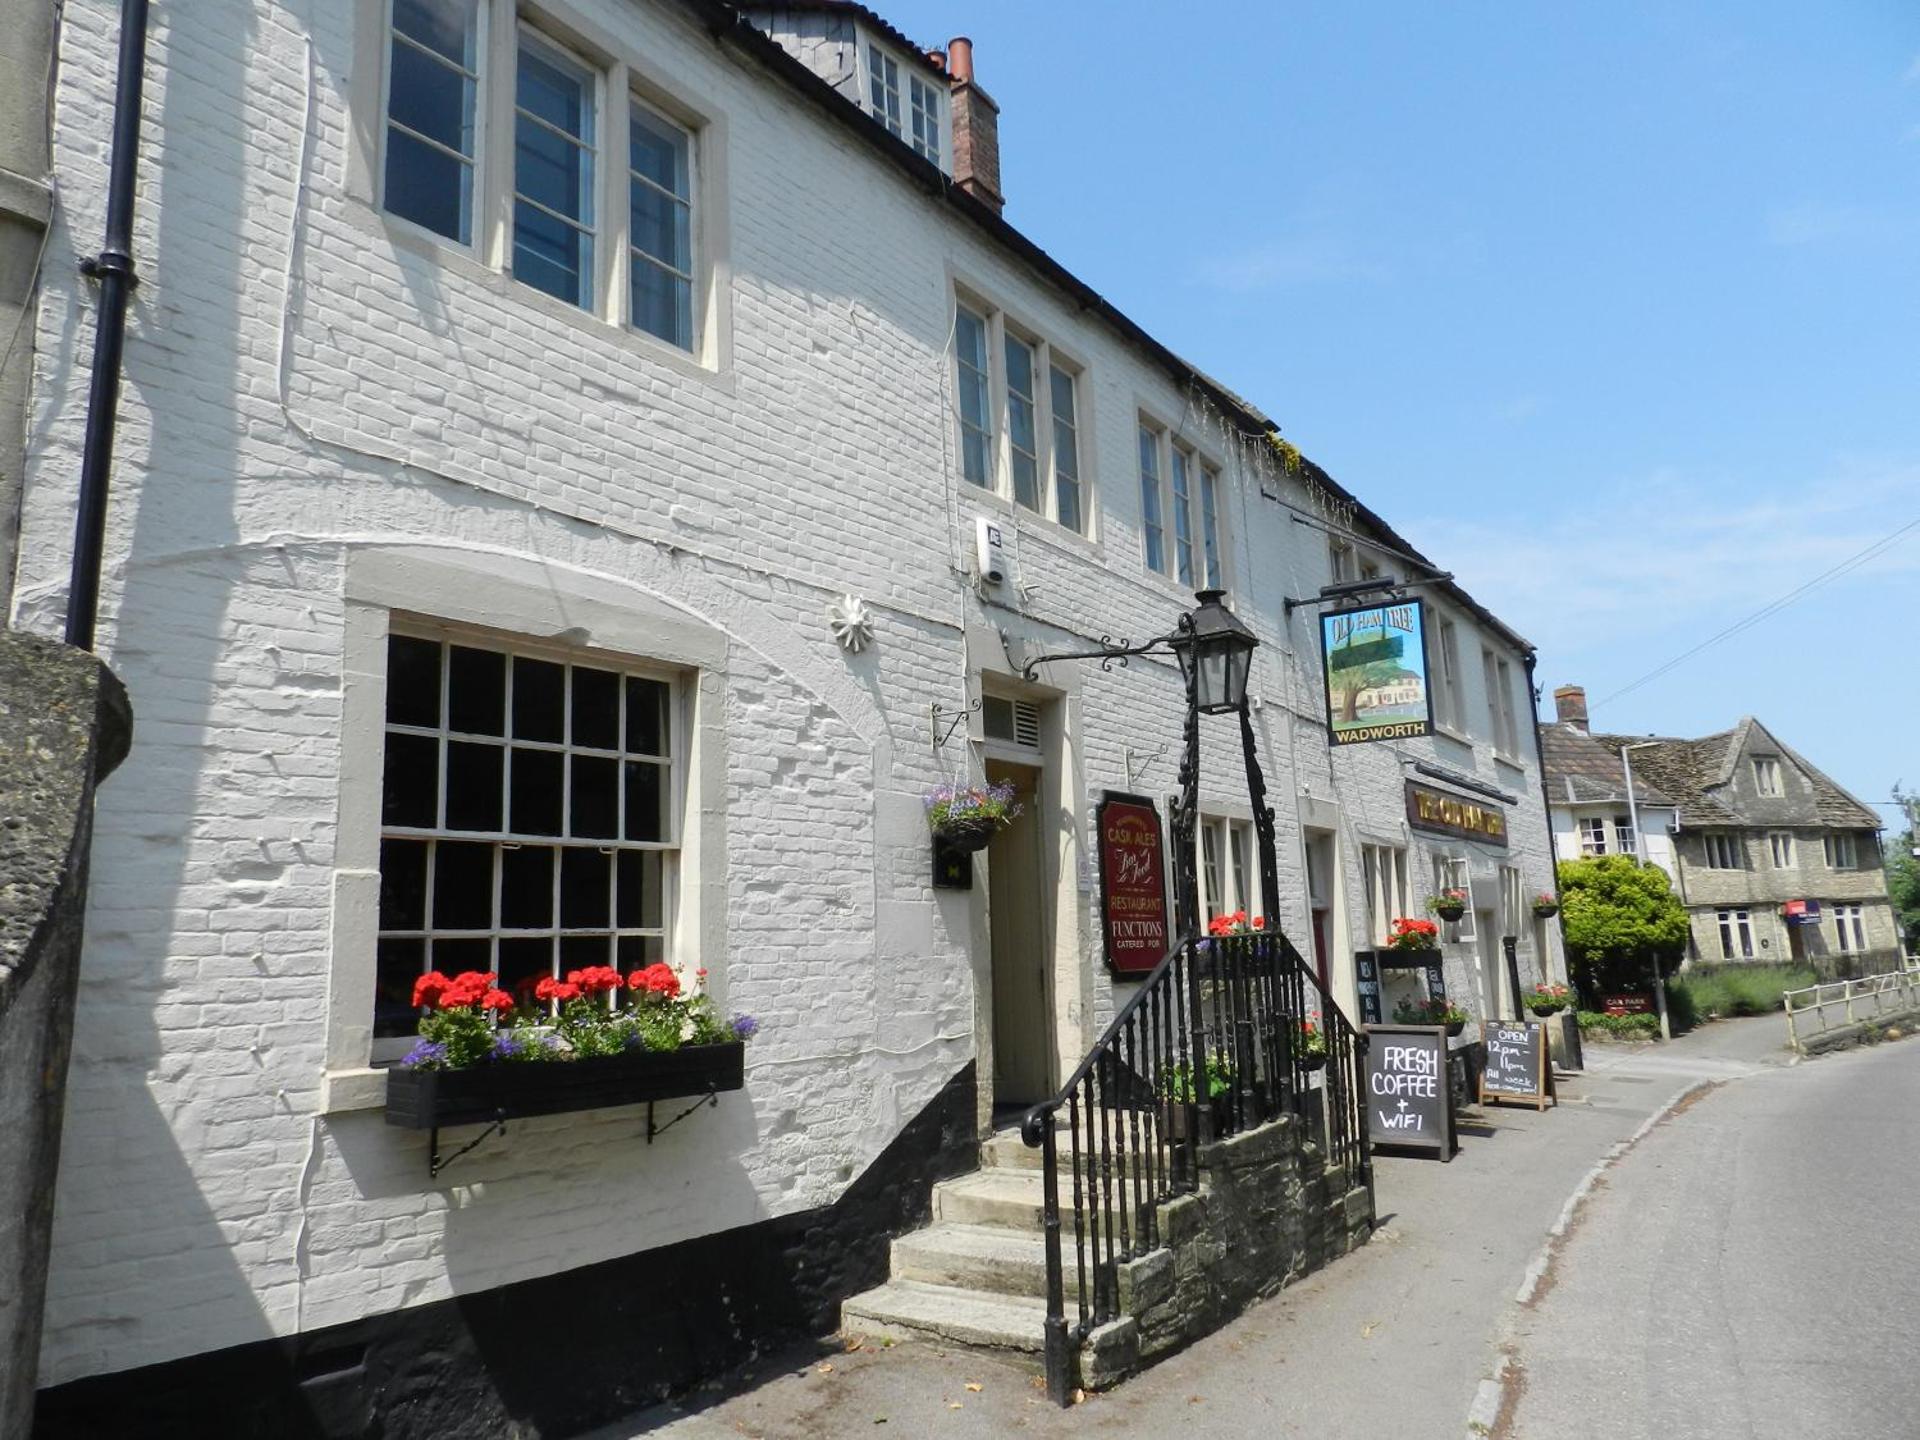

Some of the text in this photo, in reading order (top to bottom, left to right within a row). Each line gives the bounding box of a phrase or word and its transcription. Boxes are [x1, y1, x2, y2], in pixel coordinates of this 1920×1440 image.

[1386, 607, 1414, 632] TREE
[1336, 722, 1426, 743] WADWORTH
[1134, 831, 1157, 848] ALES
[1110, 895, 1162, 913] RESTAURANT
[1112, 921, 1163, 938] FUNCTIONS
[1116, 940, 1161, 949] CATERED FOR
[1498, 1030, 1528, 1042] OPEN
[1384, 1047, 1438, 1079] FRESH
[1486, 1068, 1500, 1079] All
[1371, 1072, 1438, 1098] COFFEE
[1378, 1111, 1423, 1131] WIFI
